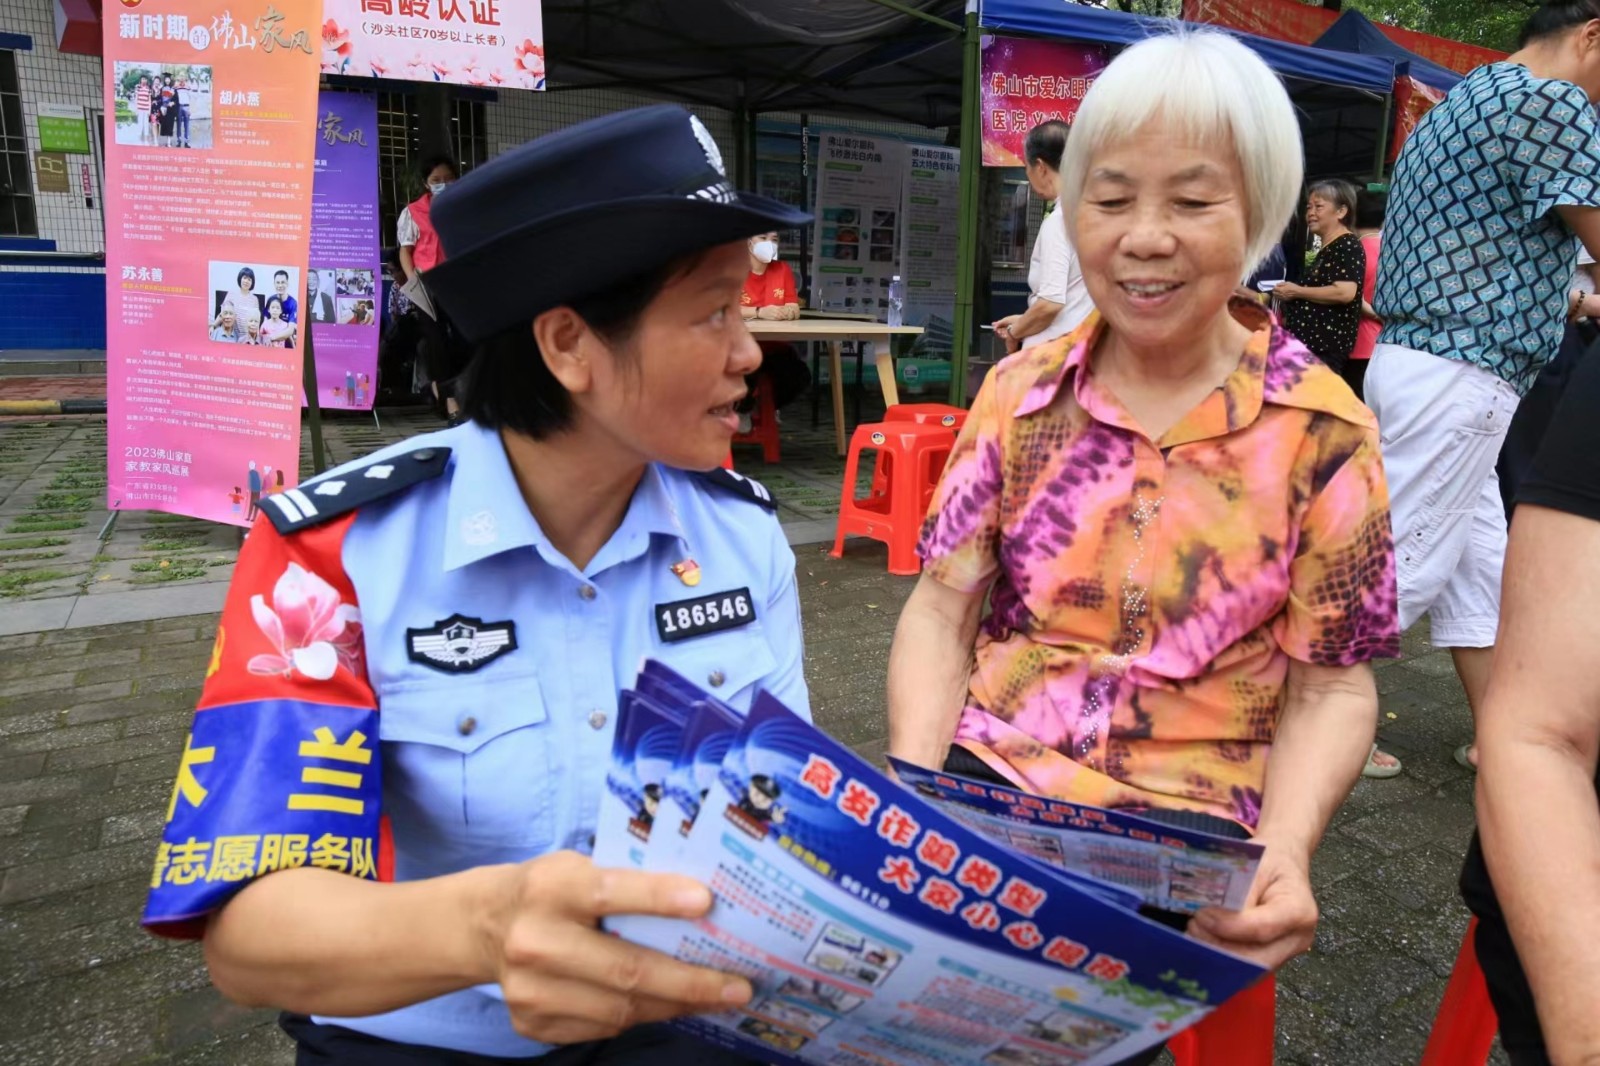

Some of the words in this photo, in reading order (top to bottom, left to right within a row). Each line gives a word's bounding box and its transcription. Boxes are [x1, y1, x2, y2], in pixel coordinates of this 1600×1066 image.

[219, 90, 261, 107] 胡小燕
[121, 265, 163, 283] 苏永善
[125, 446, 193, 464] 2023佛山家庭
[662, 595, 749, 633] 186546
